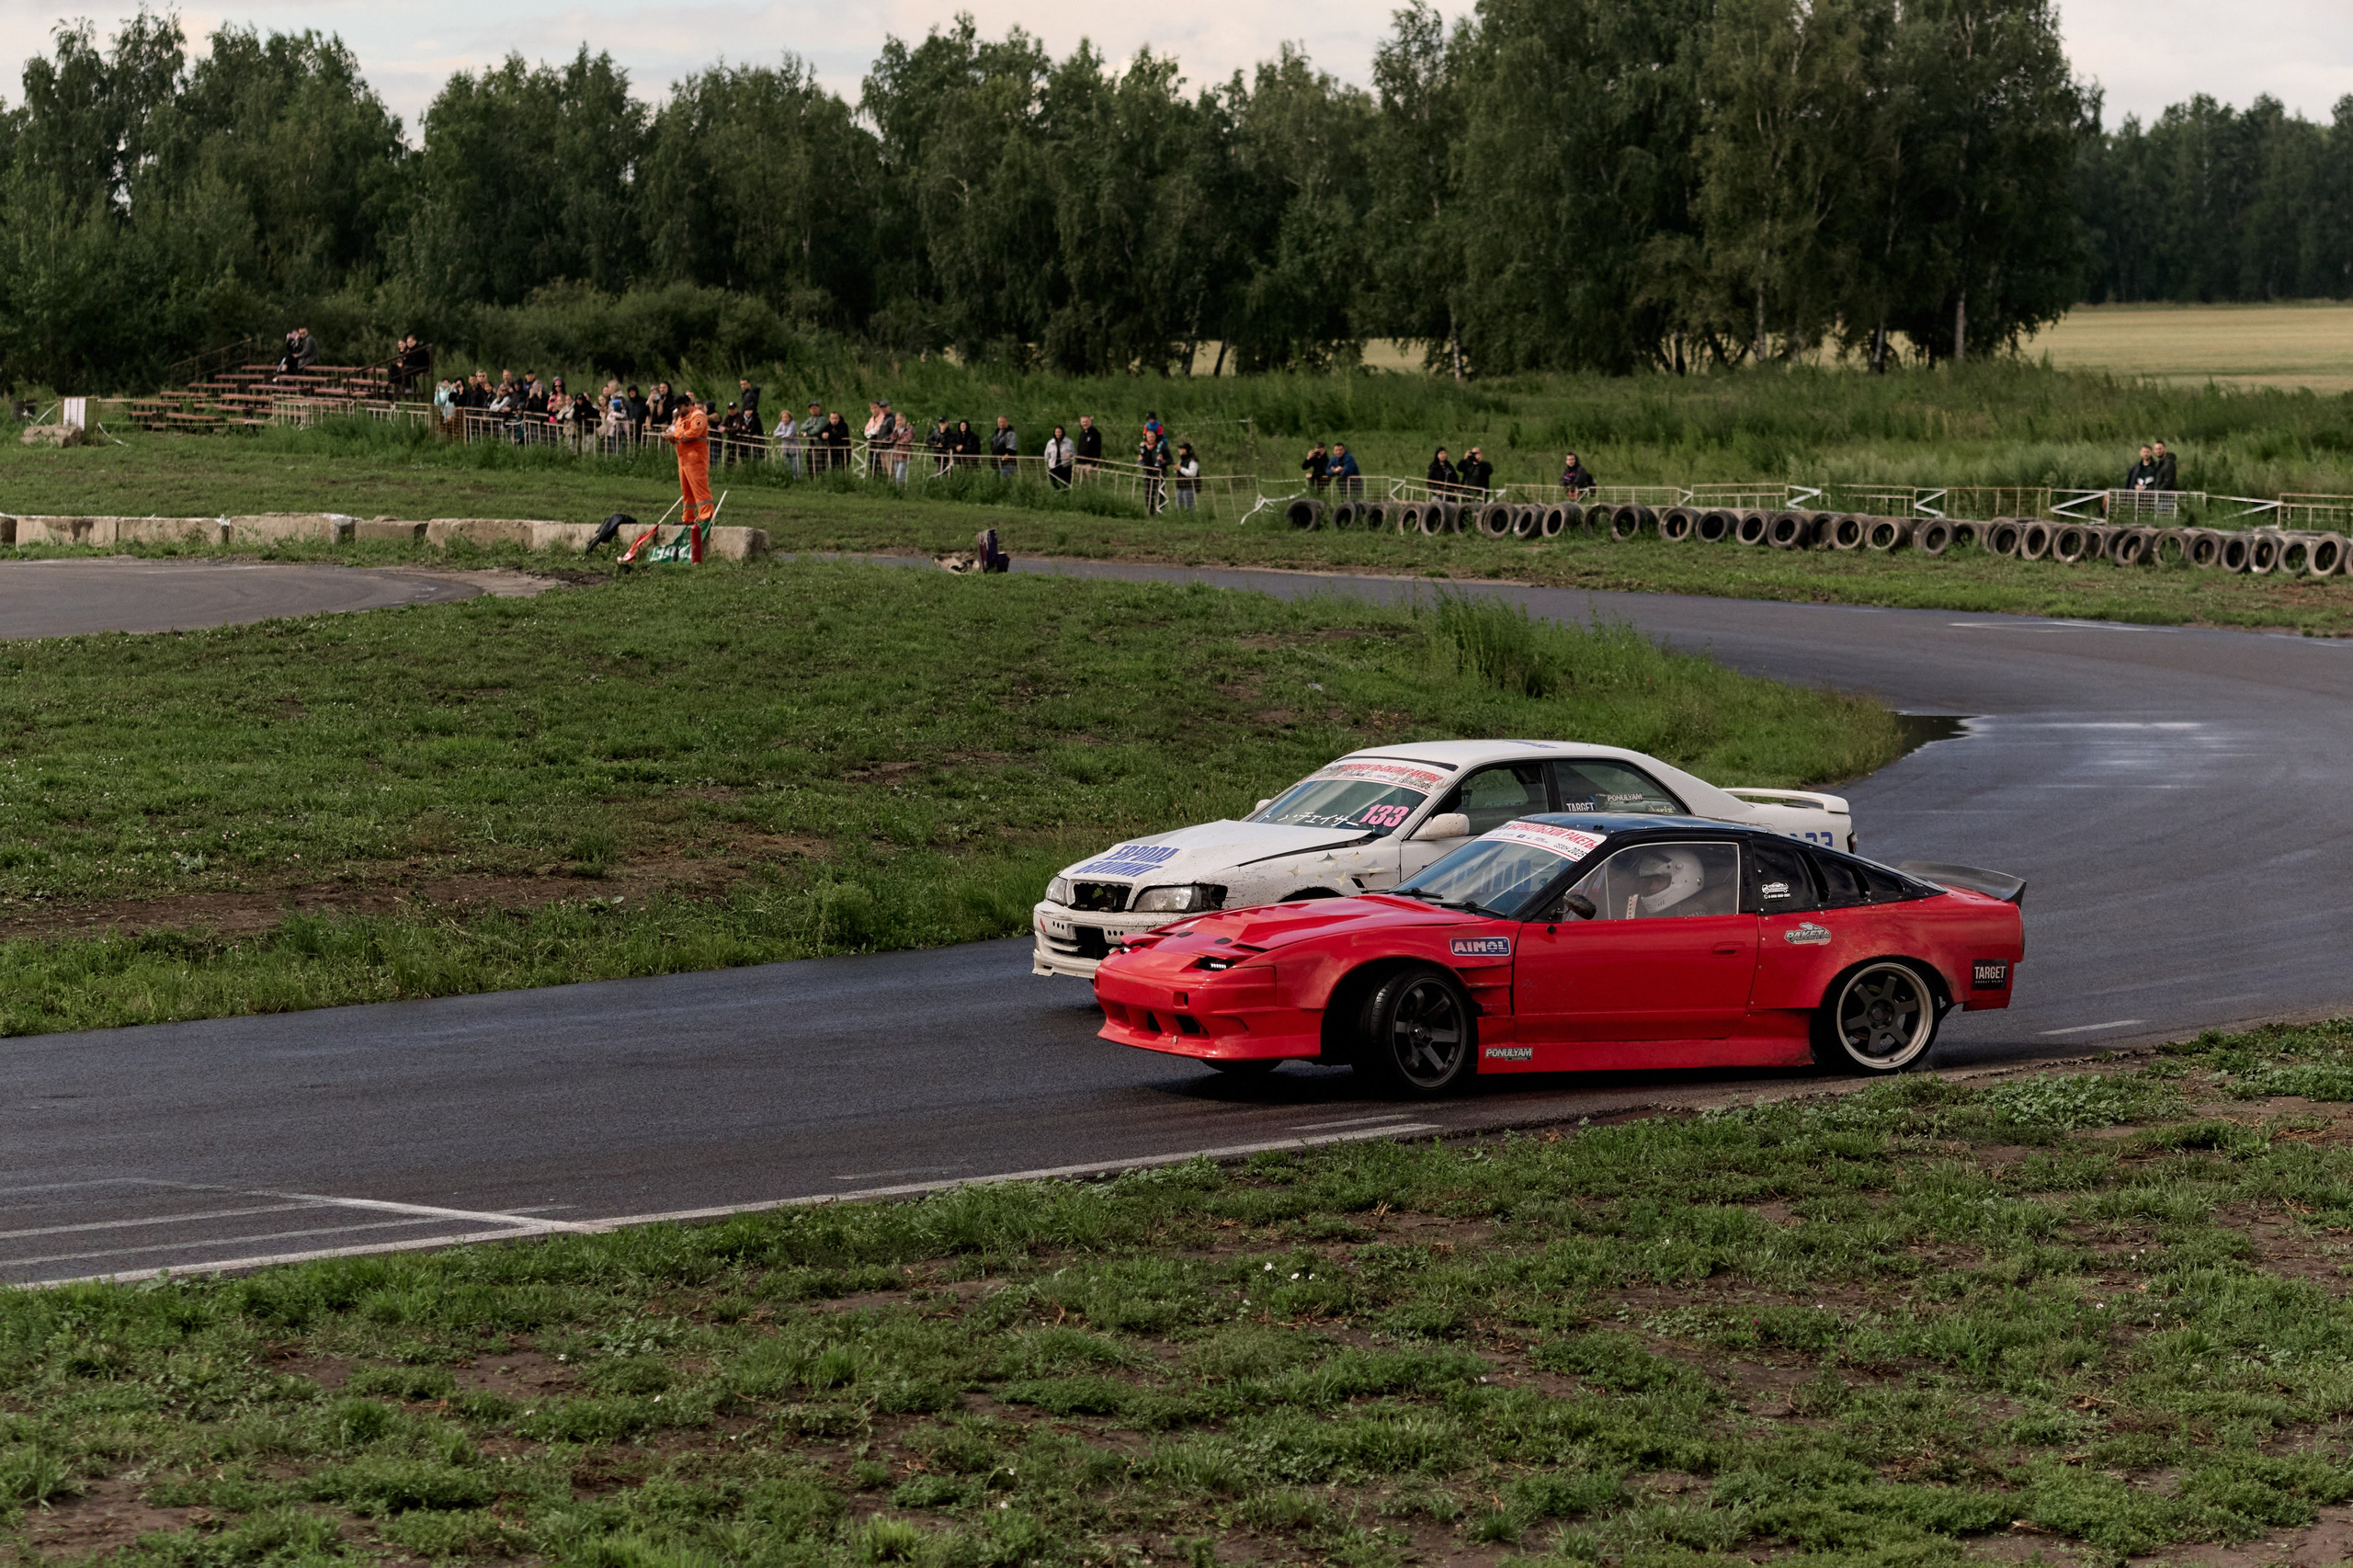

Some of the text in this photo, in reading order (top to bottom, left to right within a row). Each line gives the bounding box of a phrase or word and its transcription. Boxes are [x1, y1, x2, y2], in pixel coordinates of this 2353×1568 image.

[1607, 793, 1643, 801] PONULYAM
[1359, 804, 1409, 827] 133
[1103, 845, 1180, 864] ЕВРОПА
[1453, 940, 1508, 953] AIMOL
[1974, 966, 2006, 979] TARGET
[1485, 1048, 1532, 1057] PONULYAM
